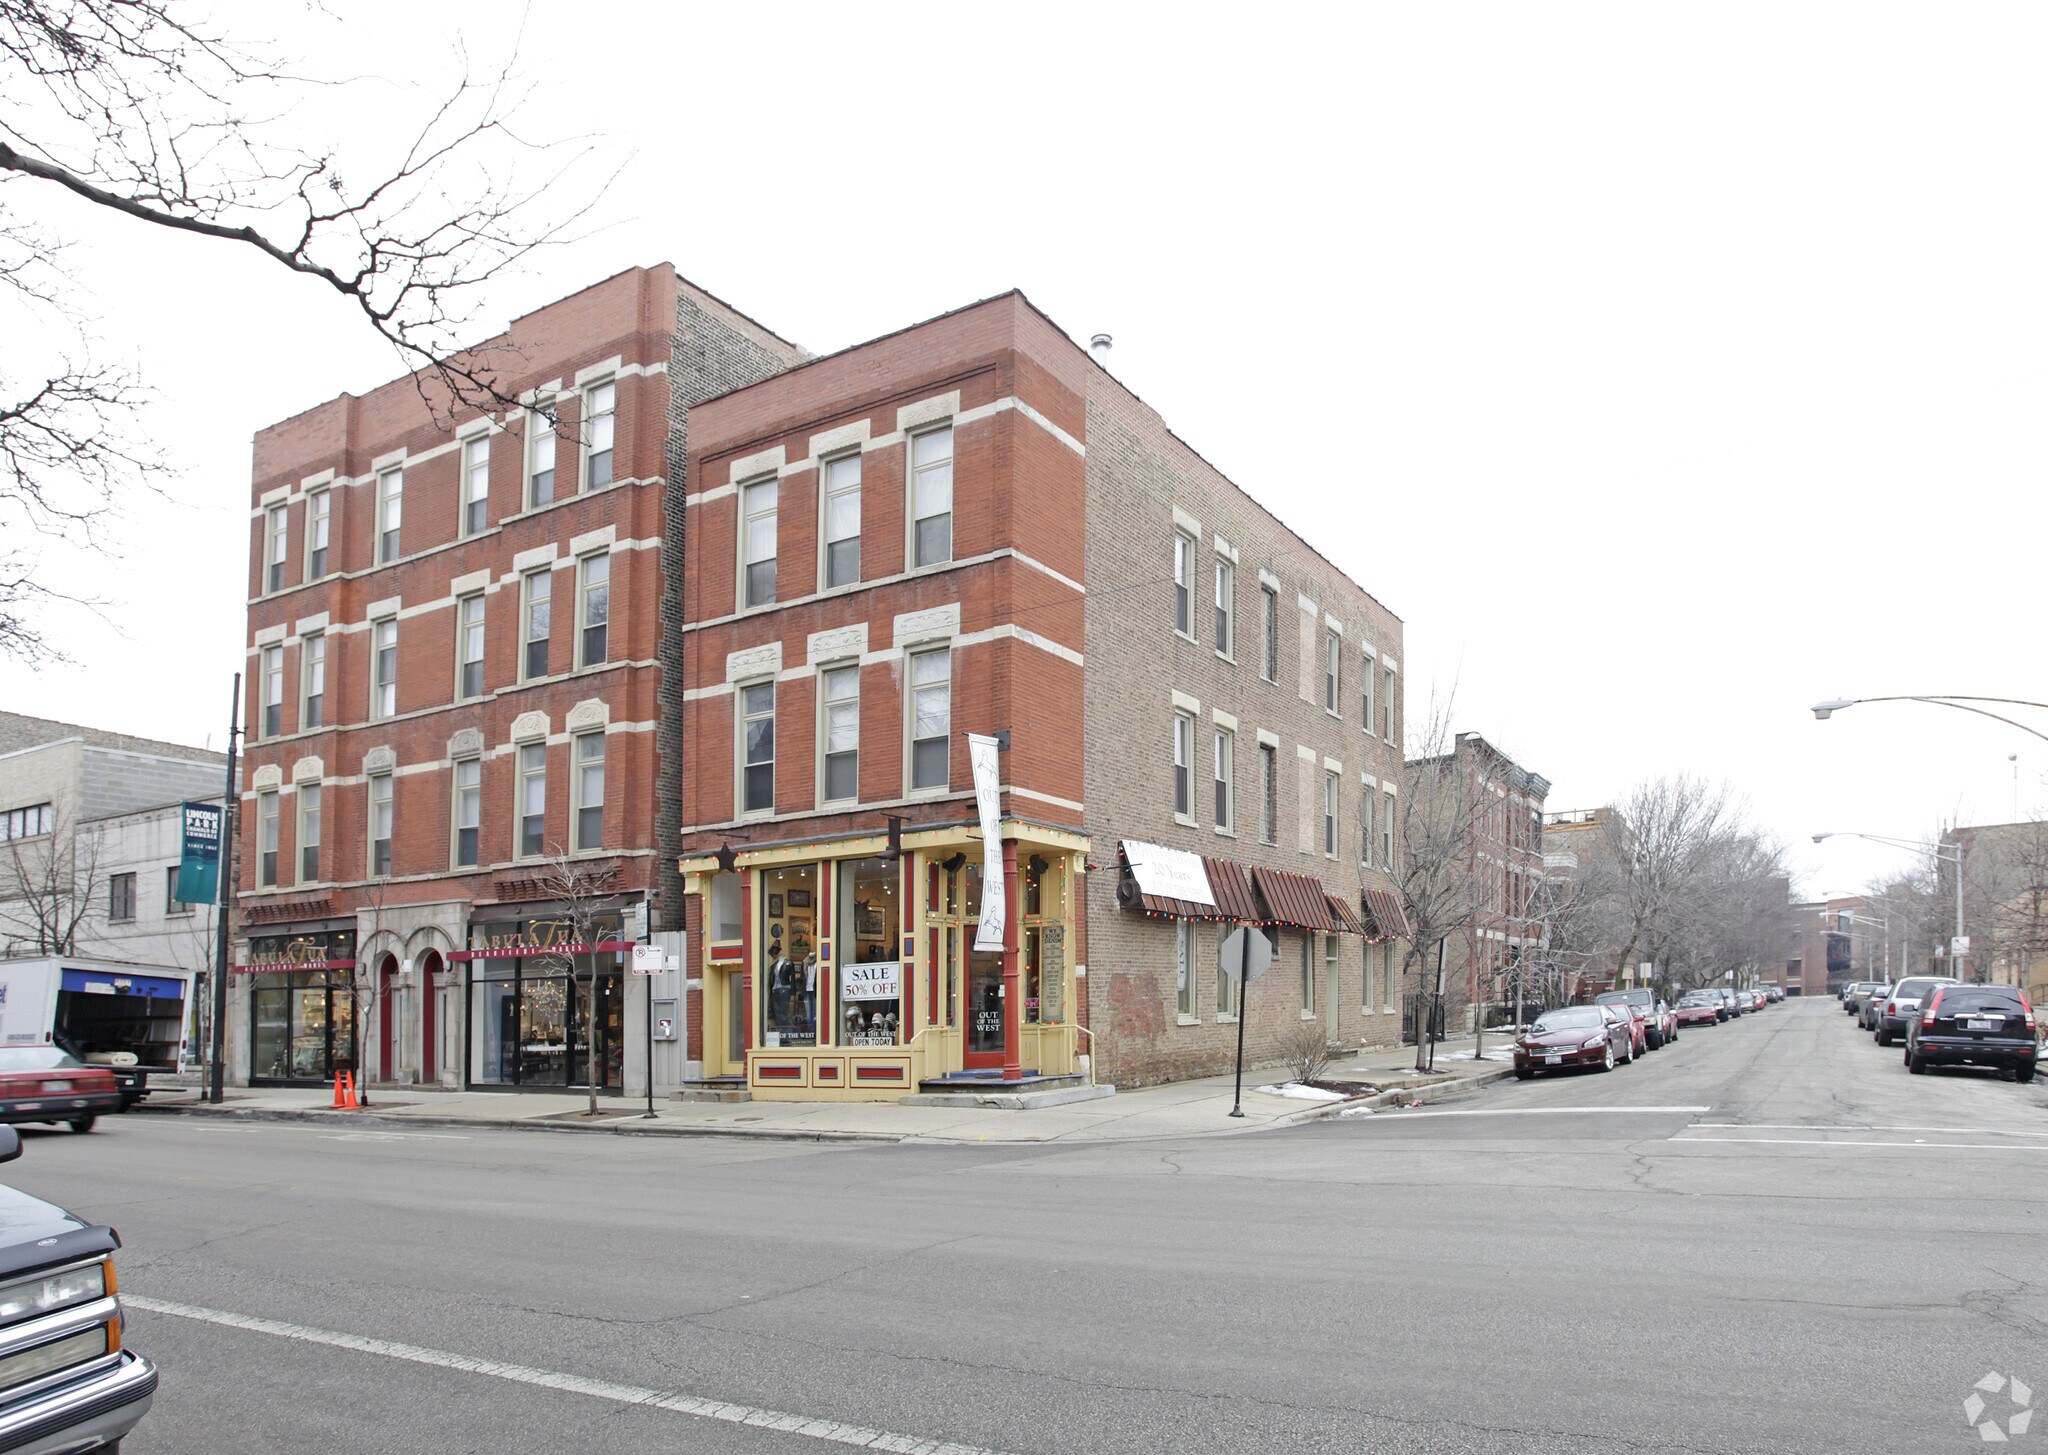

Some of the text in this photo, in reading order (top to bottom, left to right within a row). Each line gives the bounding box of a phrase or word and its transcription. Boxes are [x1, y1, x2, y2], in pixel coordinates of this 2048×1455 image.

[186, 809, 218, 821] LINCOLN
[186, 831, 217, 839] COMMERCE
[990, 849, 1001, 864] THE
[1152, 861, 1191, 880] 20 Years
[987, 880, 1004, 896] WEST
[468, 931, 540, 949] TABULA
[852, 967, 889, 981] SALE
[846, 982, 897, 996] 50% OFF
[979, 1011, 998, 1019] OUT
[855, 1038, 891, 1046] OPEN TODAY
